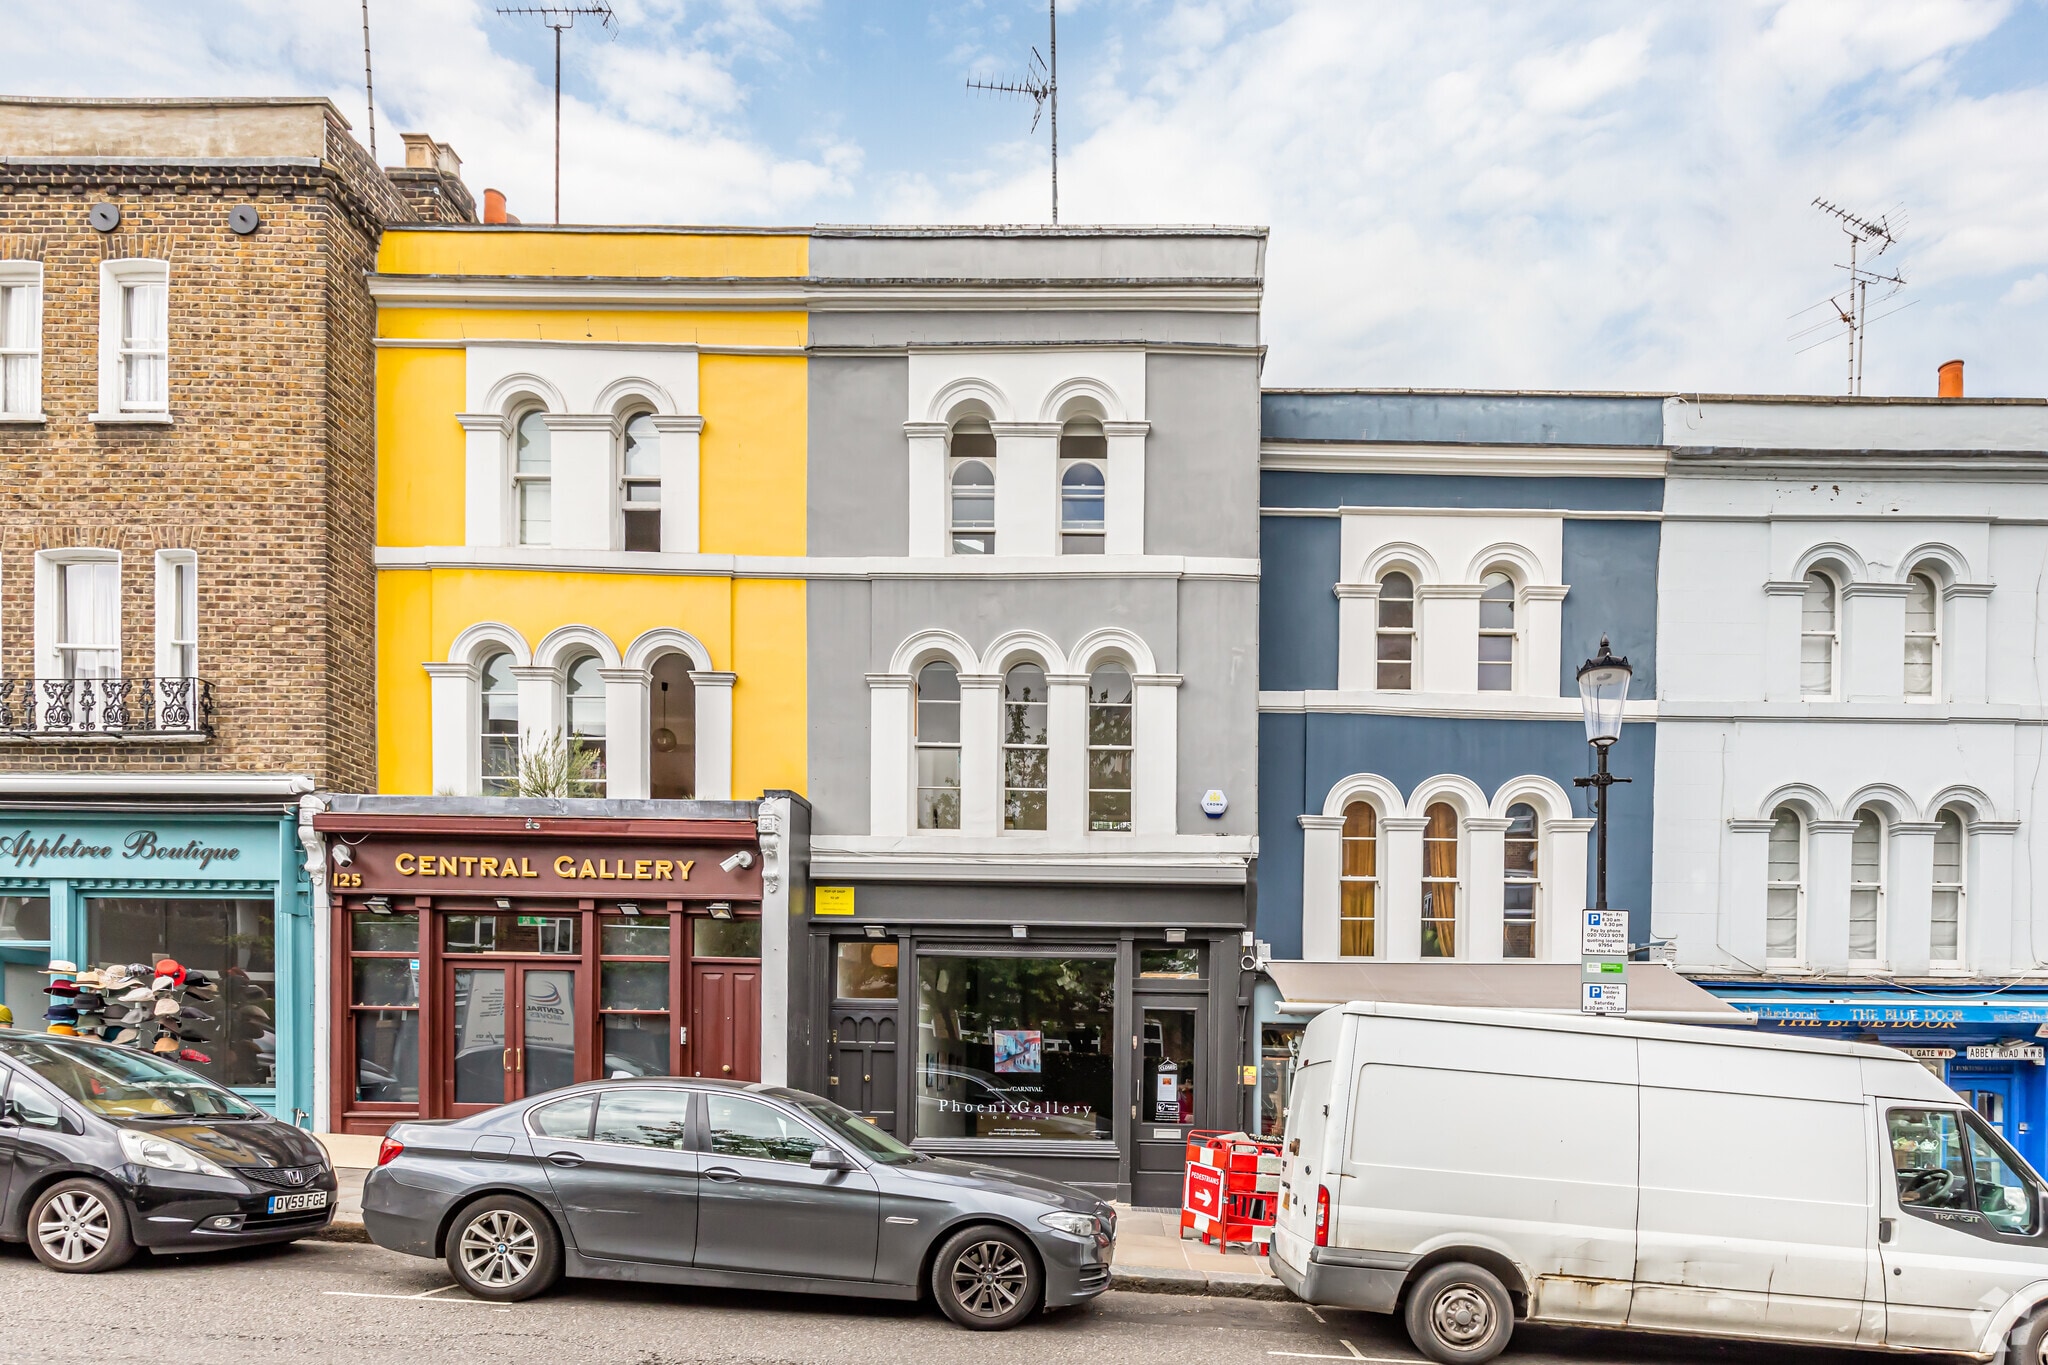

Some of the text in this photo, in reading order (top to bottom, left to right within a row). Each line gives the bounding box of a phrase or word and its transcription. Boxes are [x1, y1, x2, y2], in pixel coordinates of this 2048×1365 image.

[0, 829, 240, 870] Appletree Boutique
[395, 852, 695, 880] CENTRAL GALLERY
[333, 872, 362, 887] 125
[1850, 1008, 1879, 1021] THE
[1885, 1008, 1918, 1021] BLUE
[1924, 1009, 1964, 1021] DOOR
[1970, 1048, 1994, 1058] ABBEY
[1999, 1048, 2019, 1058] ROAD
[1191, 1171, 1220, 1186] PEDESTRIANS
[276, 1192, 326, 1210] OV59 FGE
[1933, 1212, 1981, 1223] TRANSIT
